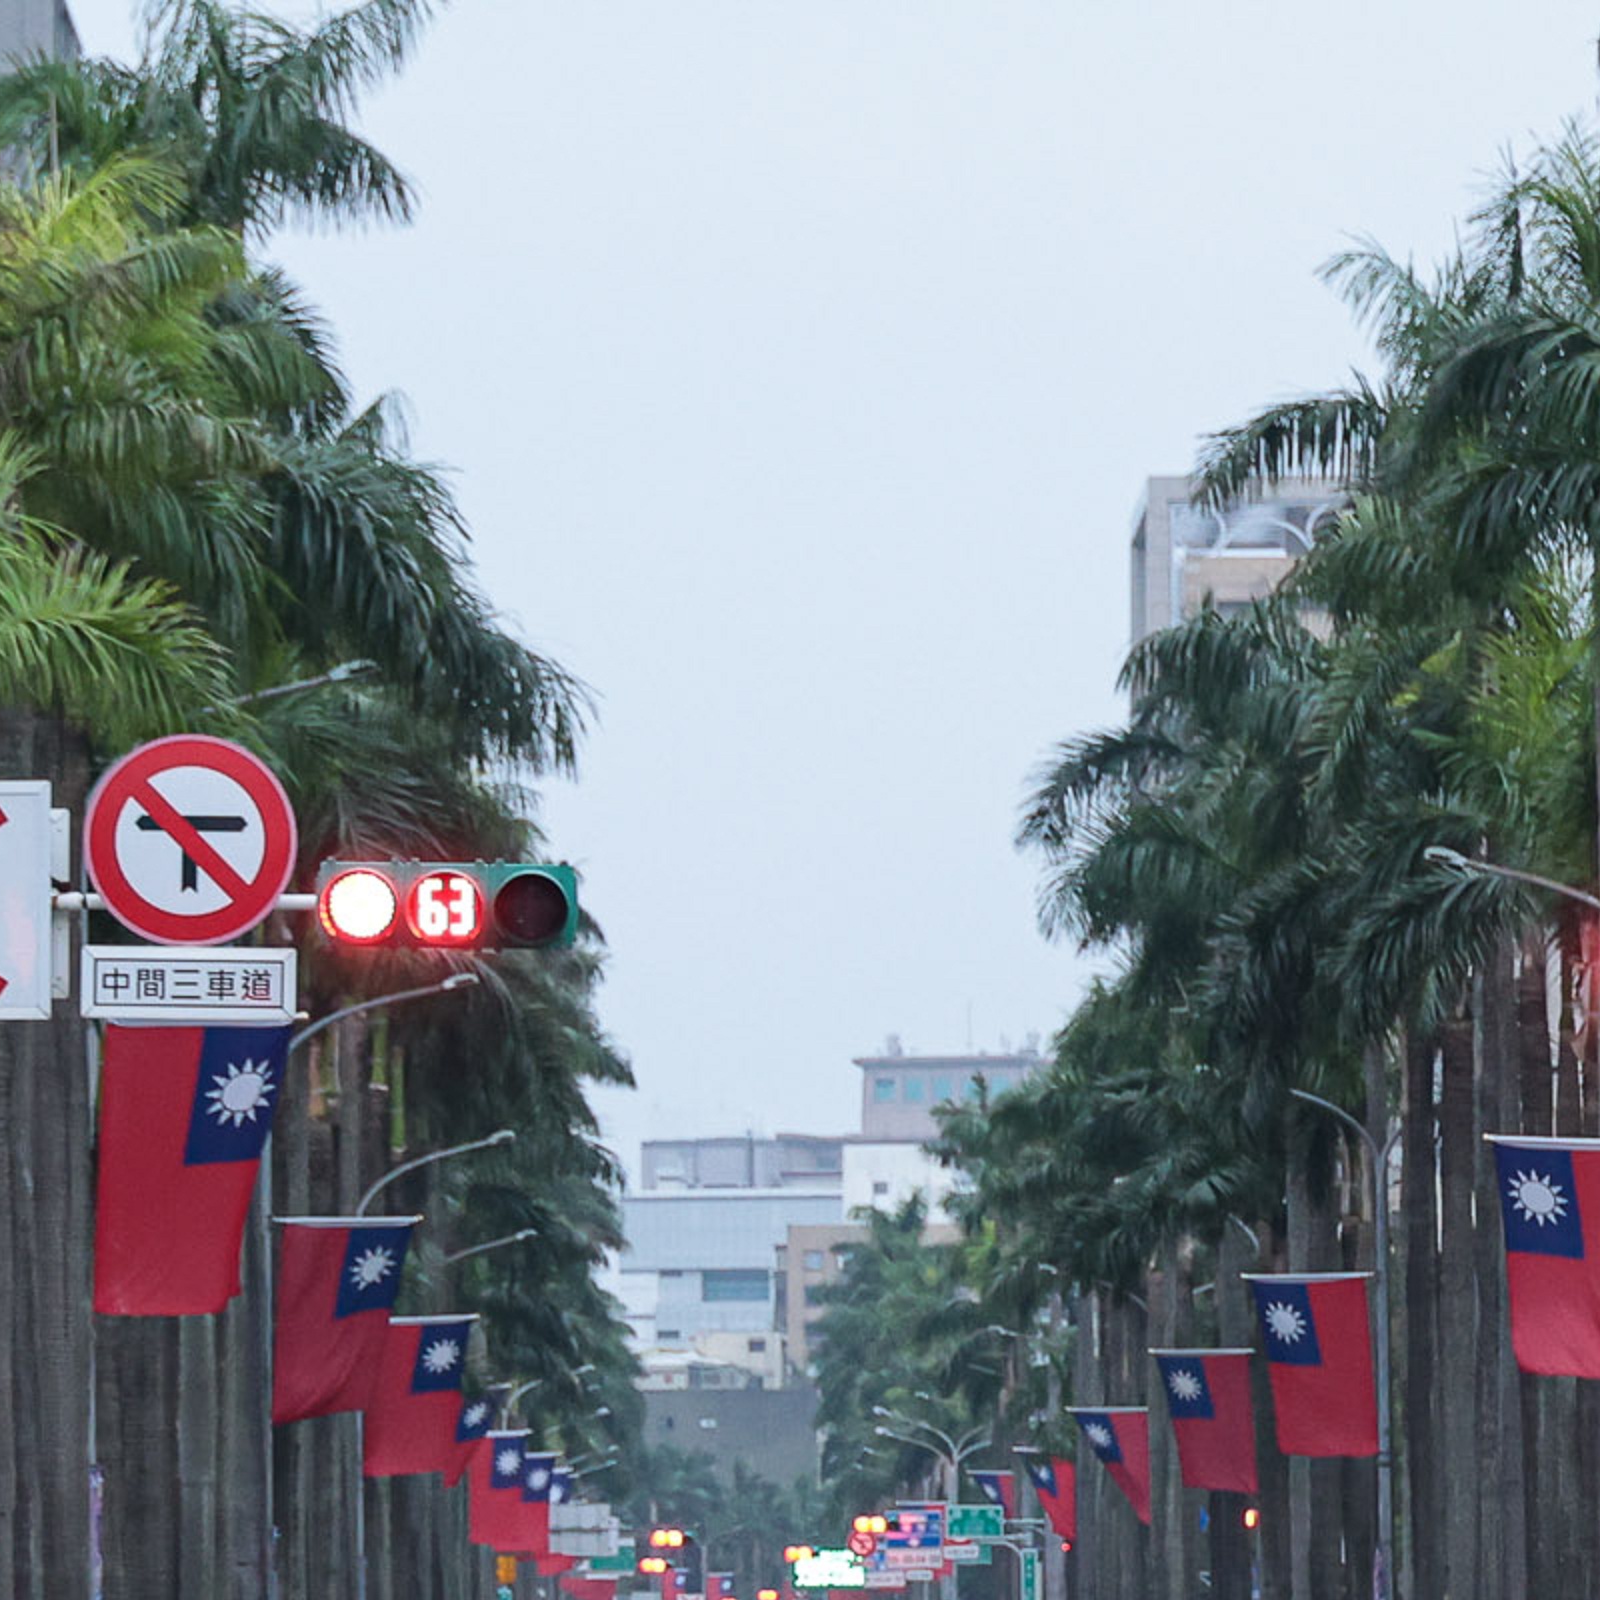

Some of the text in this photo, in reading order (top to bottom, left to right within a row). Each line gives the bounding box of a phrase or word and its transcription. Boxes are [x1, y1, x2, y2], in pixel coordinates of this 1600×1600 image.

[417, 877, 475, 937] 63
[102, 967, 273, 1001] 中間三車道
